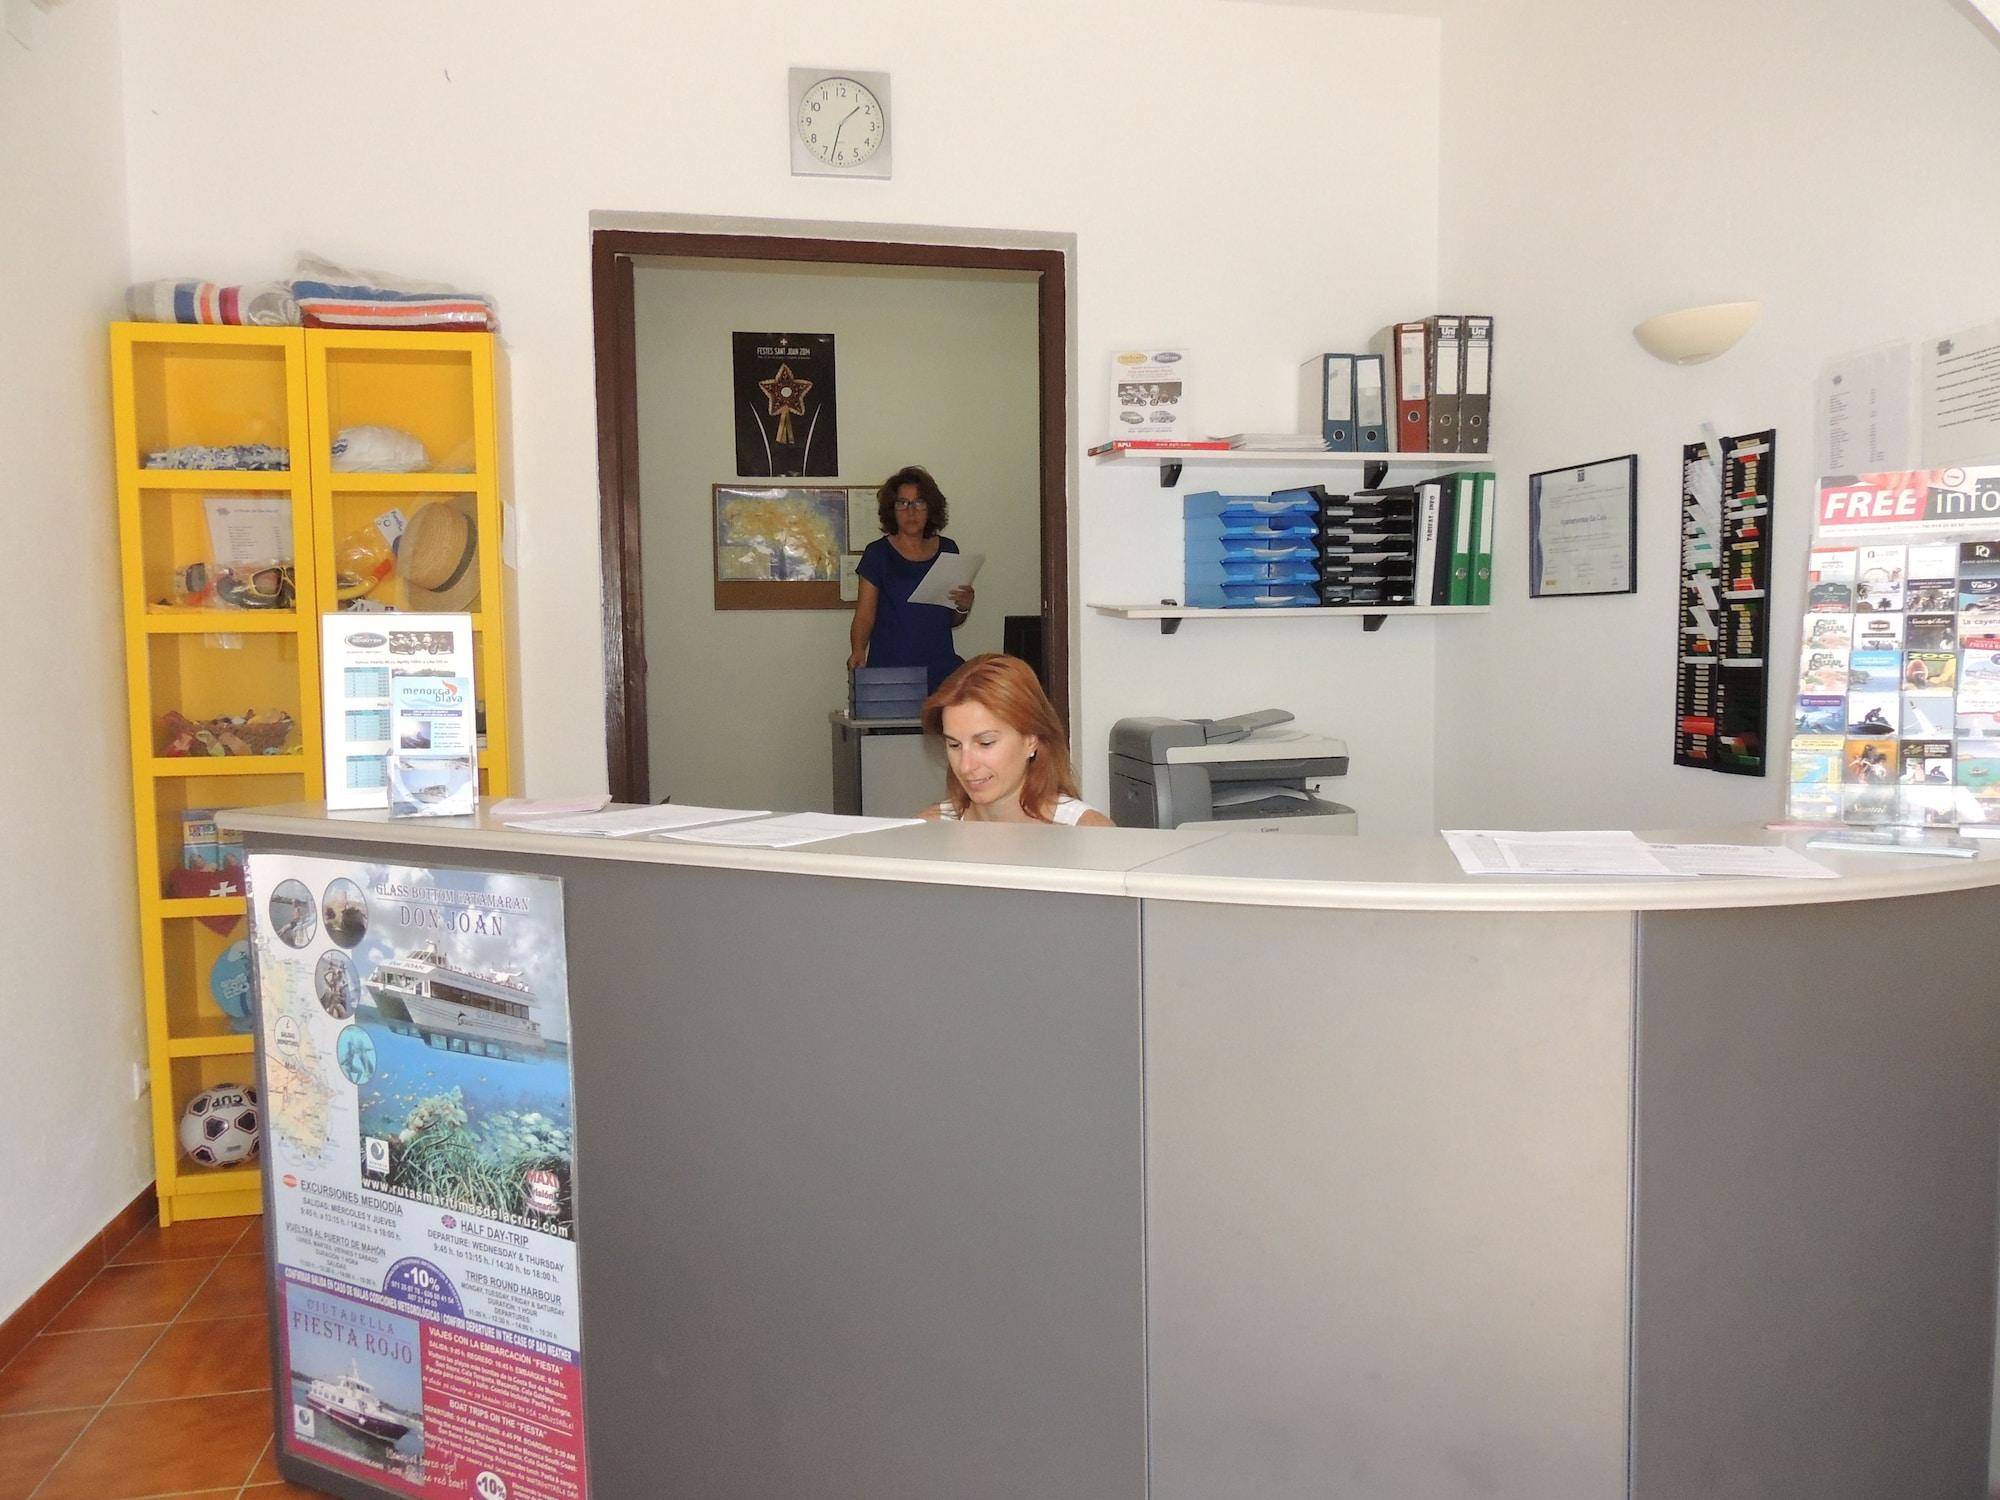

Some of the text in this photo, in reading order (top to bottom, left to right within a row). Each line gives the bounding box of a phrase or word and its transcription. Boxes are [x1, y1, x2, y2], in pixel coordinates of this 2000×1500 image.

[822, 91, 829, 101] 11
[835, 87, 846, 98] 12
[854, 93, 859, 103] 1
[810, 102, 821, 112] 10
[864, 104, 871, 115] 2
[805, 116, 812, 127] 9
[869, 121, 876, 132] 3
[810, 133, 817, 144] 8
[863, 137, 870, 147] 4
[822, 145, 829, 155] 7
[837, 151, 844, 161] 6
[853, 147, 859, 158] 5
[756, 346, 774, 355] FESTES
[774, 347, 786, 356] SANT
[1824, 486, 1917, 519] FREE
[402, 687, 451, 695] menorca
[435, 691, 463, 703] blava
[375, 883, 409, 898] GLASS
[399, 905, 503, 936] DON JOAN
[211, 1094, 243, 1108] CUP
[300, 1179, 403, 1215] EXCURSIONES MEDIODÍA
[460, 1220, 529, 1247] HALF DAY-TRIP
[313, 1228, 322, 1239] AL
[323, 1231, 349, 1246] PUERTO
[350, 1238, 360, 1249] DE
[361, 1240, 386, 1256] MAHÓN
[427, 1228, 468, 1247] DEPARTURE:
[472, 1240, 517, 1260] WEDNESDAY
[525, 1254, 564, 1273] THURSDAY
[495, 1259, 514, 1271] 14:30
[404, 1266, 440, 1292] -10%
[326, 1278, 333, 1290] EN
[333, 1280, 346, 1294] CASO
[346, 1284, 353, 1296] DE
[466, 1270, 561, 1305] TRIPS ROUND HARBOUR
[521, 1307, 537, 1317] HOUR
[292, 1310, 412, 1365] FIESTA ROJO
[443, 1313, 572, 1362] CONFIRM DEPARTURE IN THE CASE OF BAD WEATHER
[428, 1326, 563, 1376] VIAJES CON LA EMBARCACIÓN "FIESTA"
[449, 1398, 547, 1440] BOAT TRIPS ON THE "FIESTA"
[477, 1475, 506, 1499] -10%
